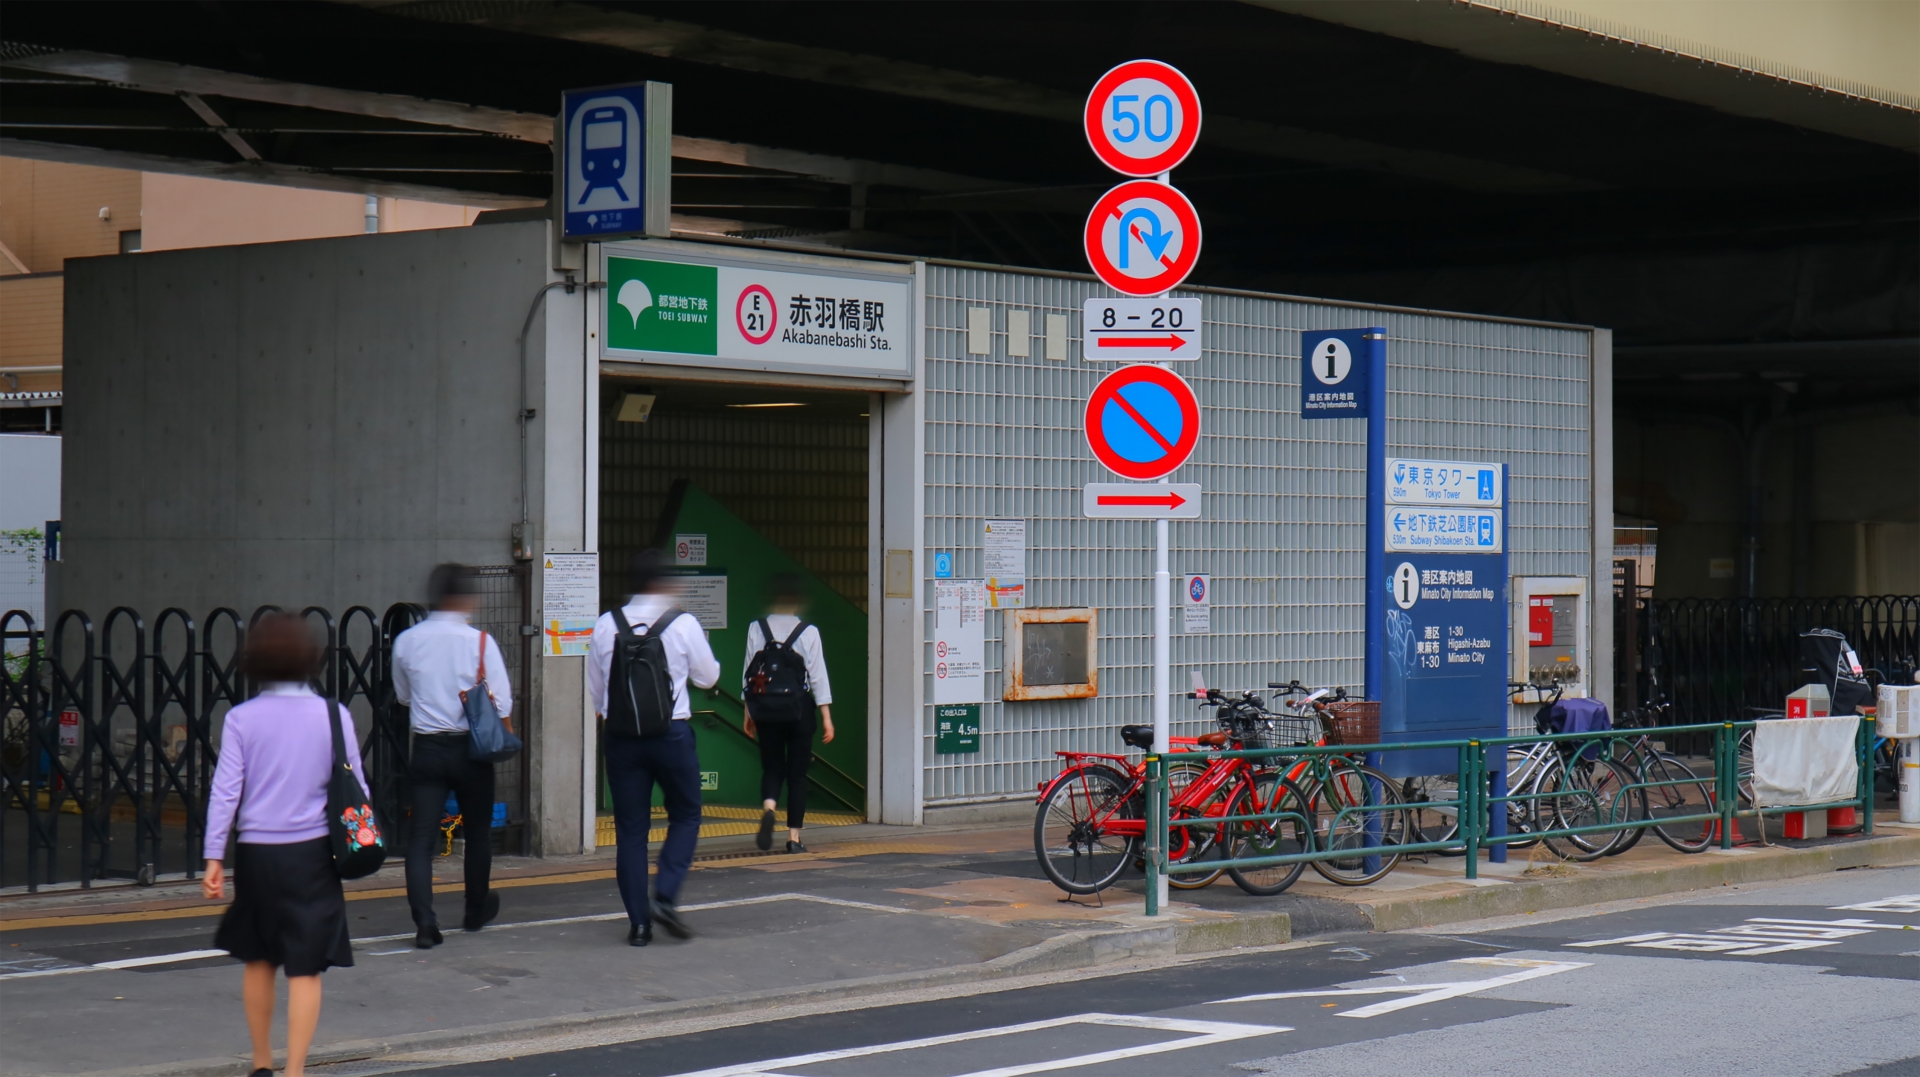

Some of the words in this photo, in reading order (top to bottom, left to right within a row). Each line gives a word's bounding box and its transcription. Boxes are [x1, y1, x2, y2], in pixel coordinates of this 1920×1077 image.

[1112, 94, 1173, 143] 50
[658, 294, 708, 311] 都営地下鉄
[753, 295, 760, 311] E
[658, 311, 675, 321] TOEI
[677, 312, 708, 324] SUBWAY
[789, 294, 885, 333] 赤羽橋駅
[747, 313, 764, 331] 21
[782, 328, 866, 349] Akabanebashi
[870, 335, 892, 351] Sta.
[1308, 392, 1354, 402] 港区案内地図
[1348, 401, 1357, 410] Map
[1408, 466, 1476, 486] 東京タワー
[1424, 488, 1441, 500] Tokyo
[1443, 489, 1461, 499] Tower
[1408, 514, 1477, 533] 地下鉄芝公園駅
[1392, 534, 1407, 545] 530m
[1410, 535, 1432, 546] Subway
[1434, 535, 1464, 546] Shibakoen
[1464, 536, 1475, 546] Sta.
[1421, 570, 1473, 585] 港区案内地図
[1421, 588, 1440, 599] Minato
[1440, 588, 1452, 601] City
[1452, 588, 1482, 599] Information
[1482, 588, 1494, 601] Map
[1424, 626, 1440, 639] 港区
[1448, 626, 1463, 636] 1-30
[1417, 641, 1440, 654] 東麻布
[1448, 639, 1491, 651] Higashi-Azabu
[1421, 656, 1440, 668] 1-30
[1447, 653, 1470, 663] Minato
[1471, 652, 1485, 664] City
[958, 723, 978, 735] 4.5m
